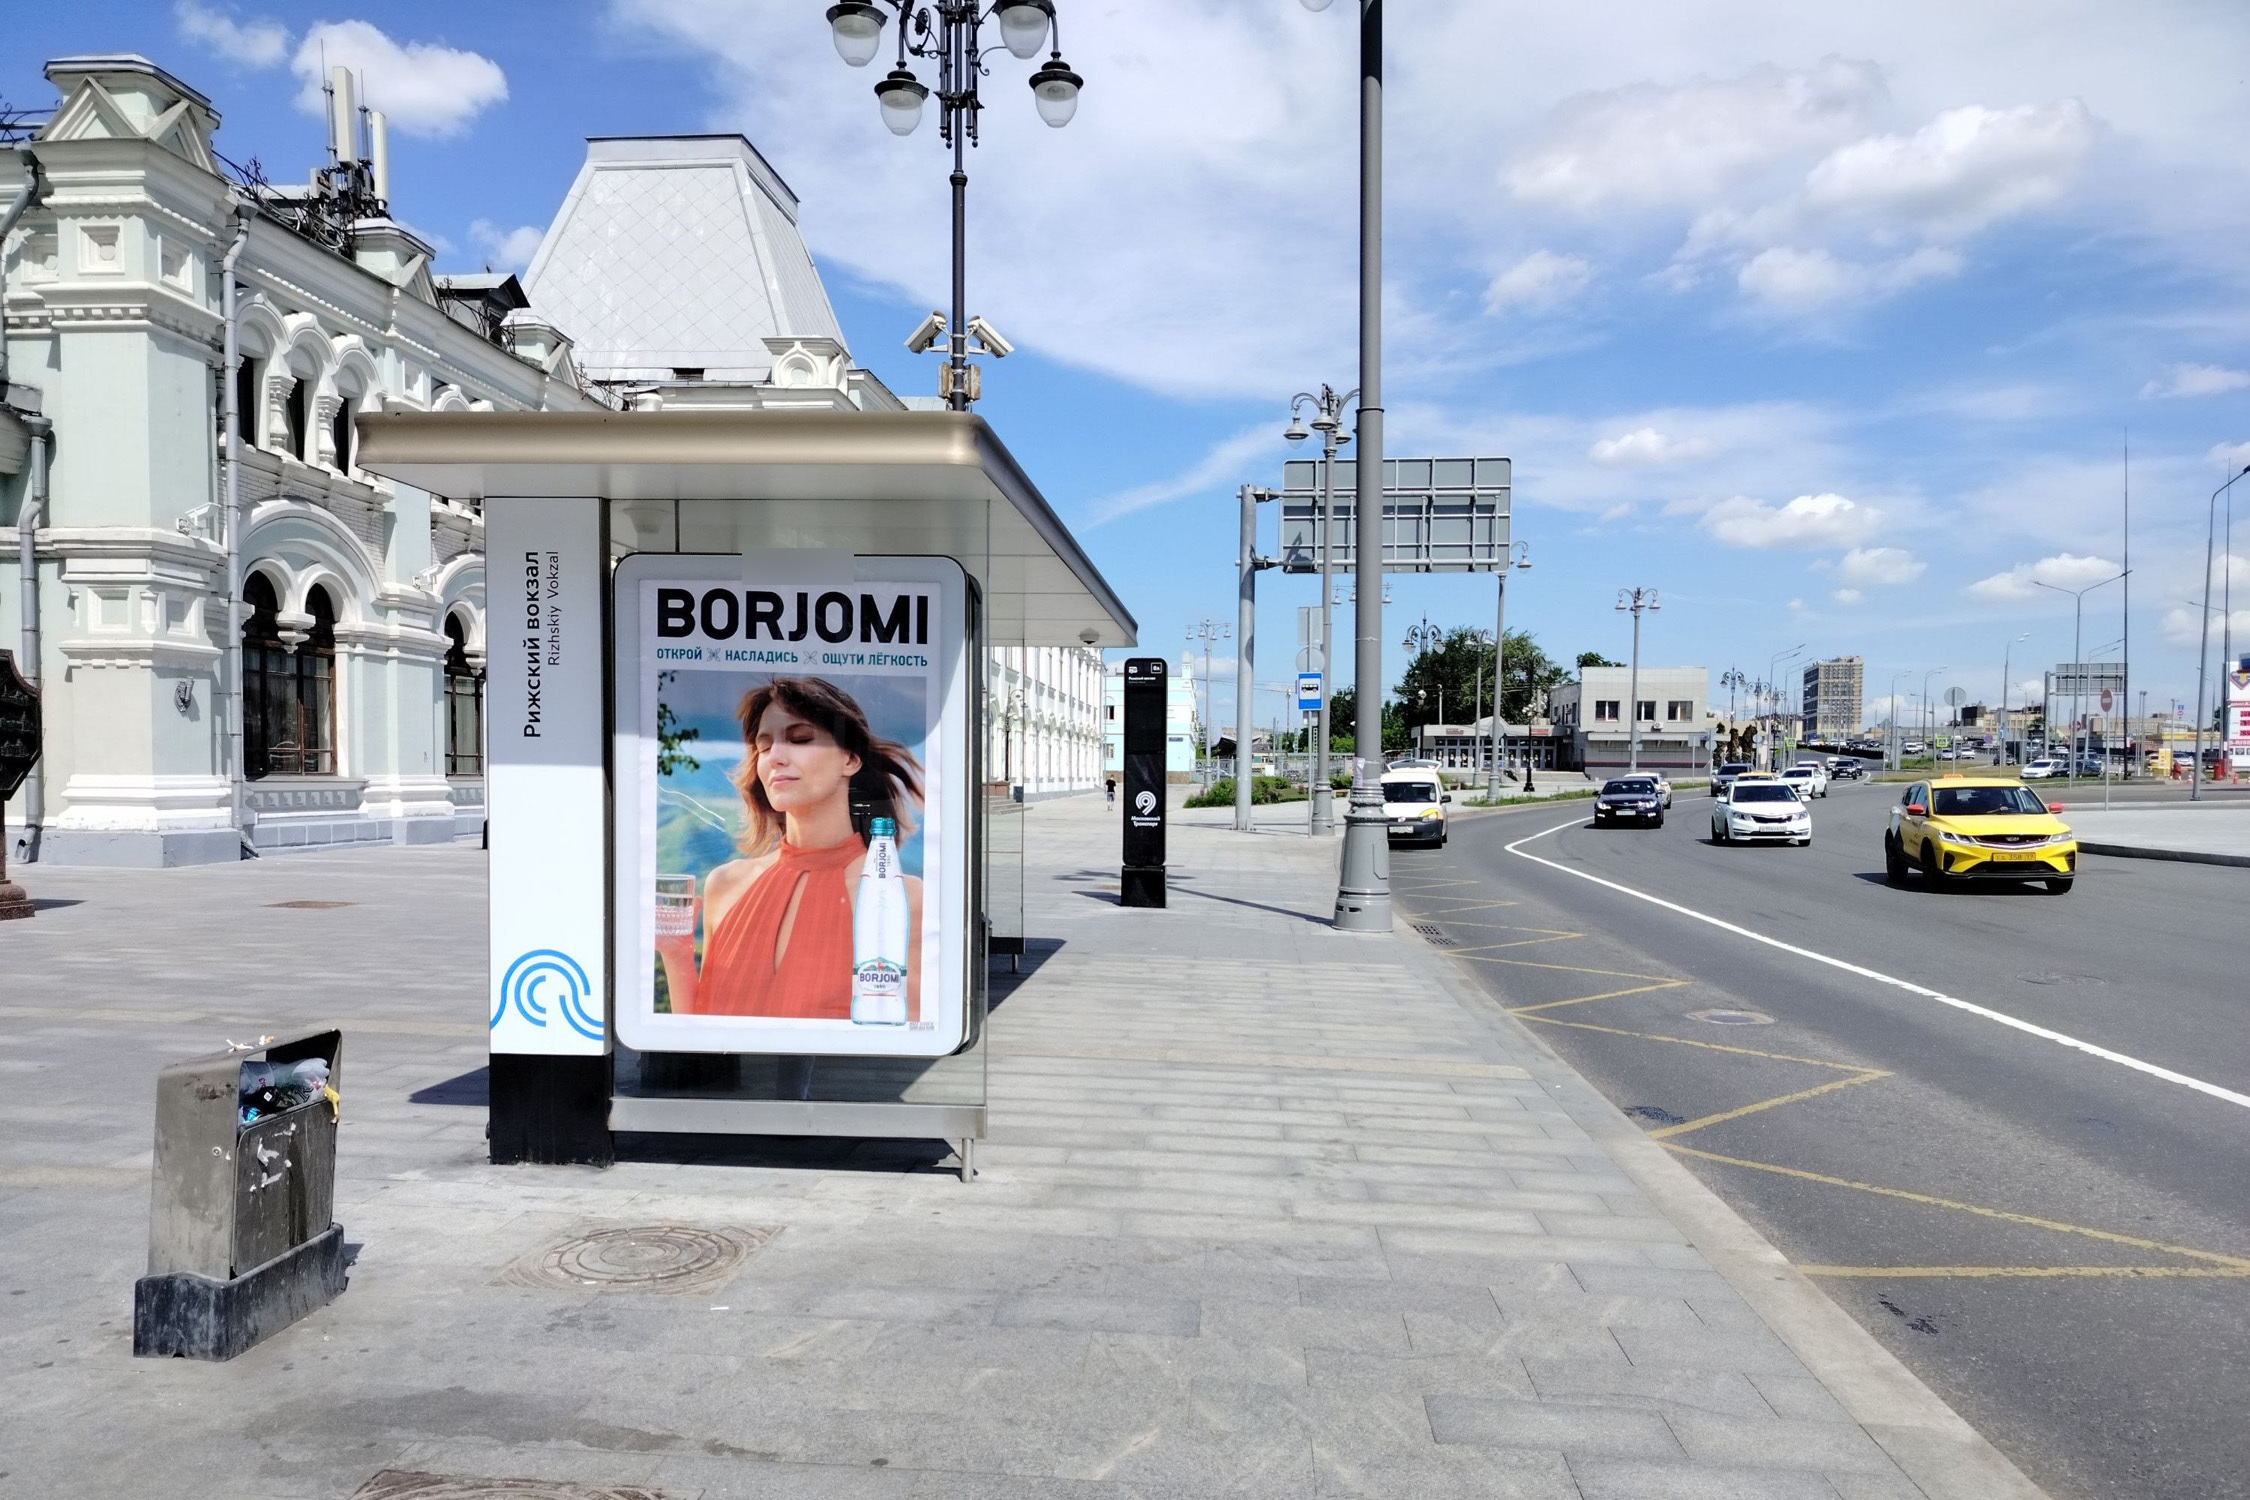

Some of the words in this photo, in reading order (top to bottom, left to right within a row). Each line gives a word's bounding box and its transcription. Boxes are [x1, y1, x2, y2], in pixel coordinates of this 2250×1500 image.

[525, 551, 540, 630] вокзал
[545, 551, 560, 599] Vokzal
[546, 605, 562, 666] Rizhskiy
[657, 587, 929, 645] BORJOMI
[656, 646, 703, 661] ОТКРОЙ
[725, 650, 799, 665] НАСЛАДИСЬ
[822, 653, 864, 667] ОЩУТИ
[868, 652, 929, 667] ЛЁГКОСТЬ
[522, 637, 541, 738] Рижский
[878, 842, 887, 878] BORJOMI
[859, 972, 900, 983] BORJOMI
